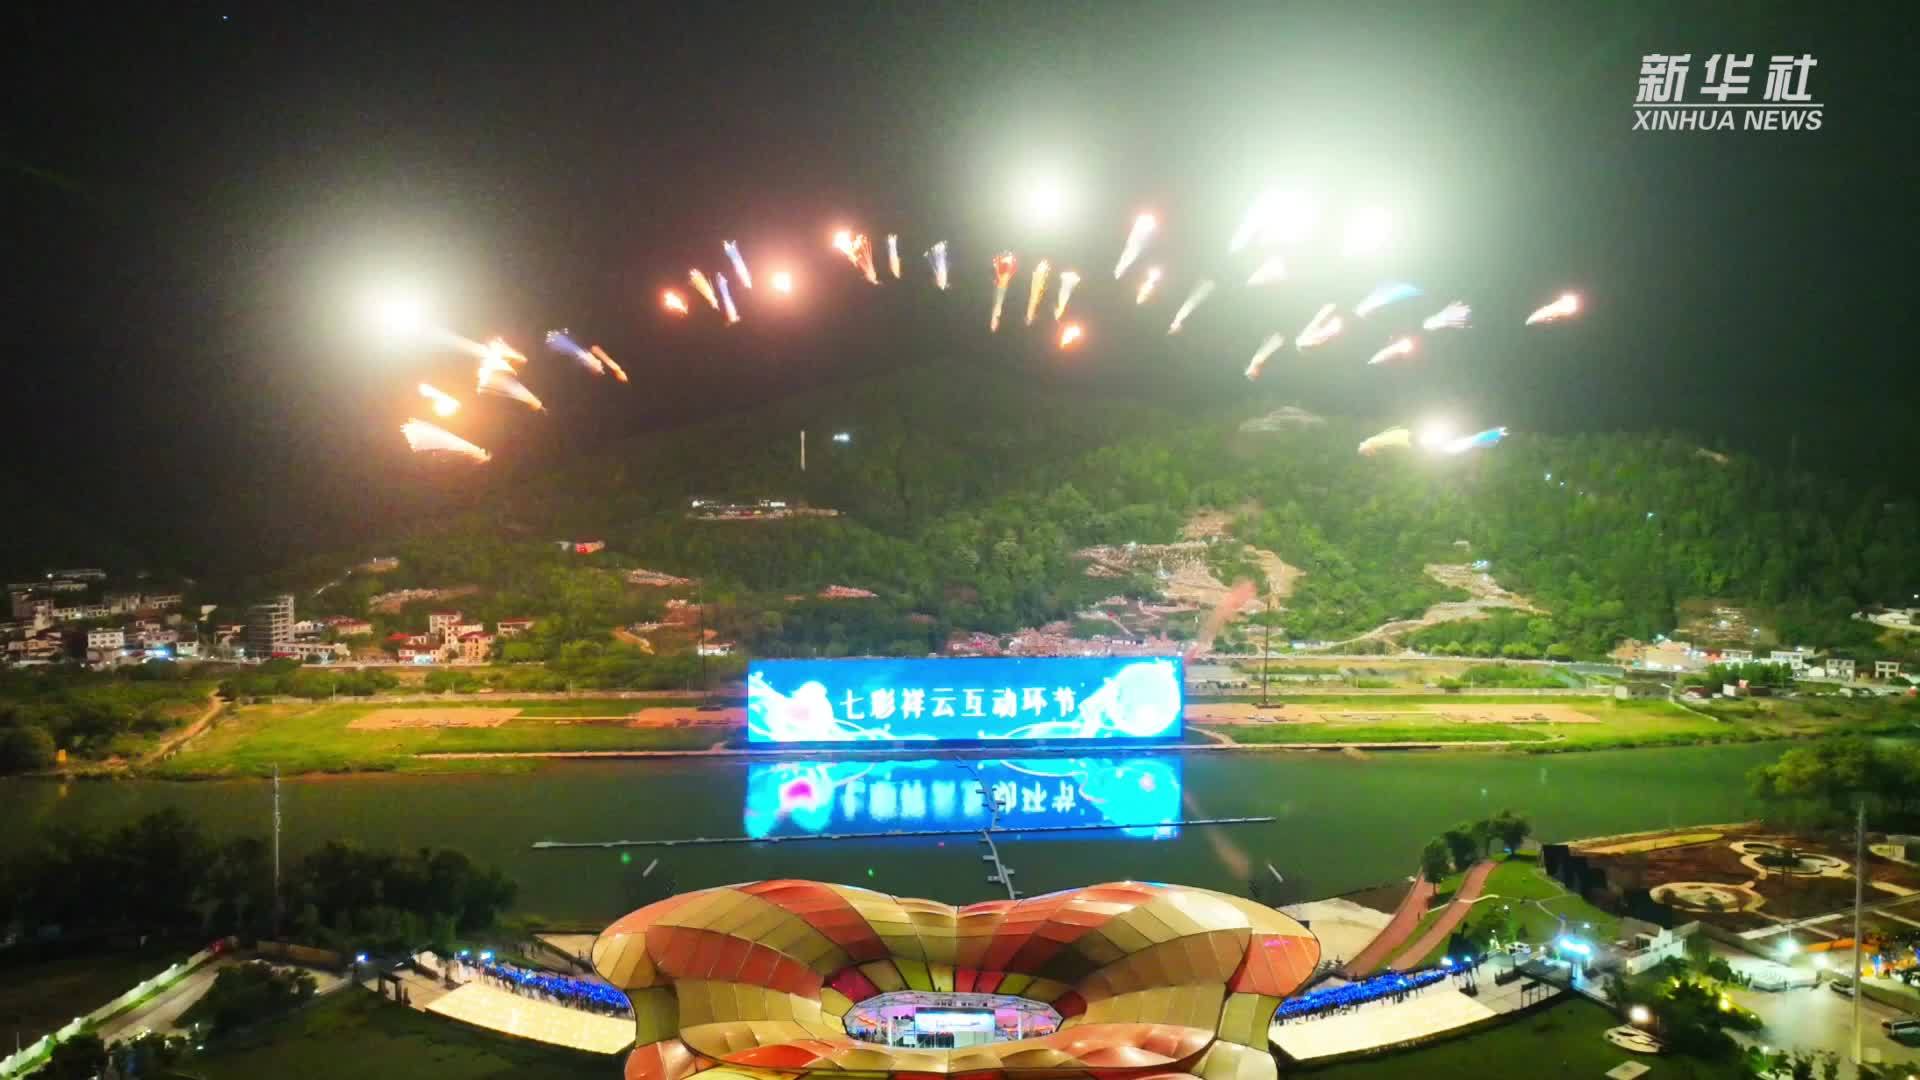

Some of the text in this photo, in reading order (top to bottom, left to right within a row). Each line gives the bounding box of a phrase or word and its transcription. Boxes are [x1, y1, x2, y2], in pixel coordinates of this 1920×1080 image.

[840, 687, 1077, 719] 七彩祥云互动环节
